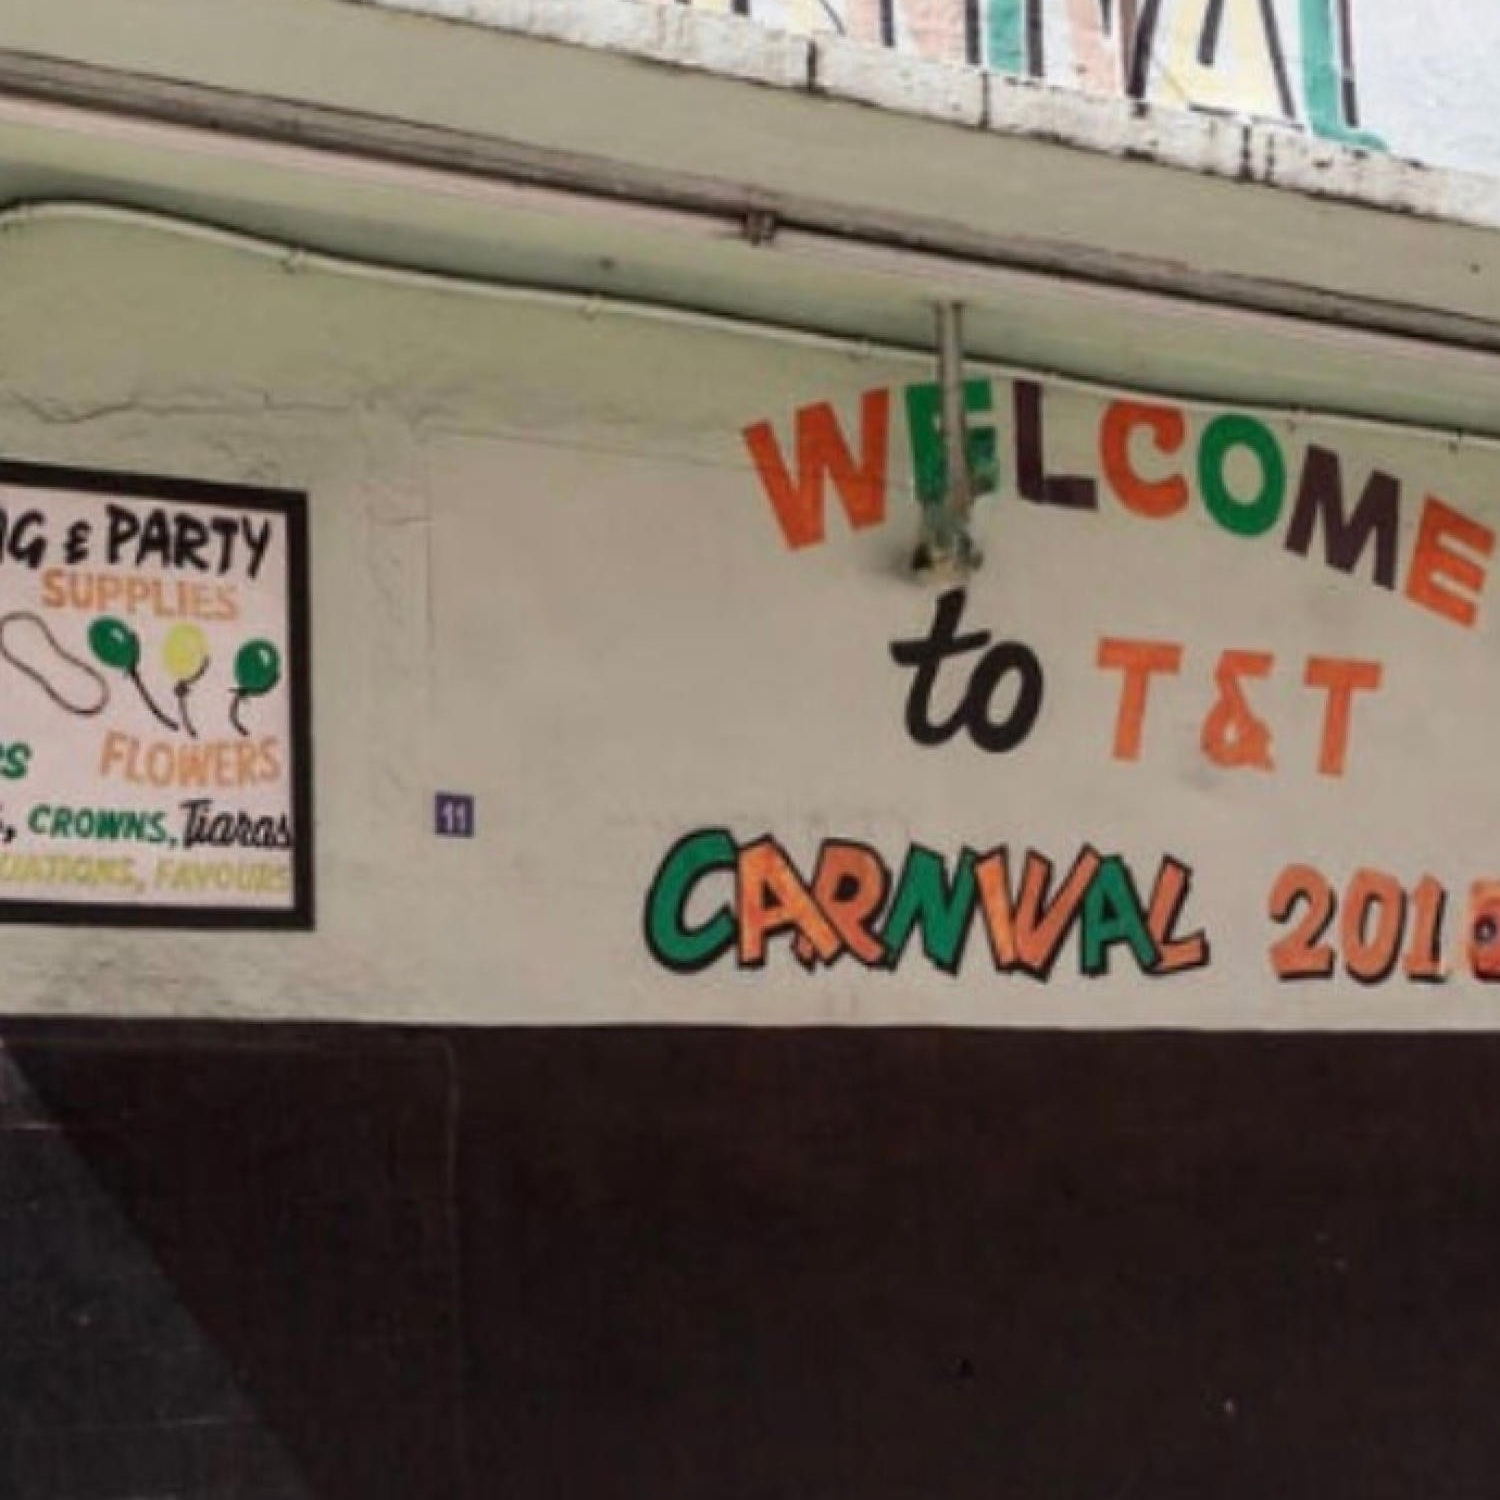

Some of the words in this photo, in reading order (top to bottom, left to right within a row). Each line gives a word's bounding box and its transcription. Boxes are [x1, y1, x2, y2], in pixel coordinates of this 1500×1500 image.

[105, 503, 271, 580] PARTY
[742, 378, 1496, 628] WELCOME
[40, 567, 240, 621] SUPPLIES
[889, 588, 1044, 753] to
[100, 729, 280, 788] FLOWERS
[643, 827, 1210, 984] CARNIVAL
